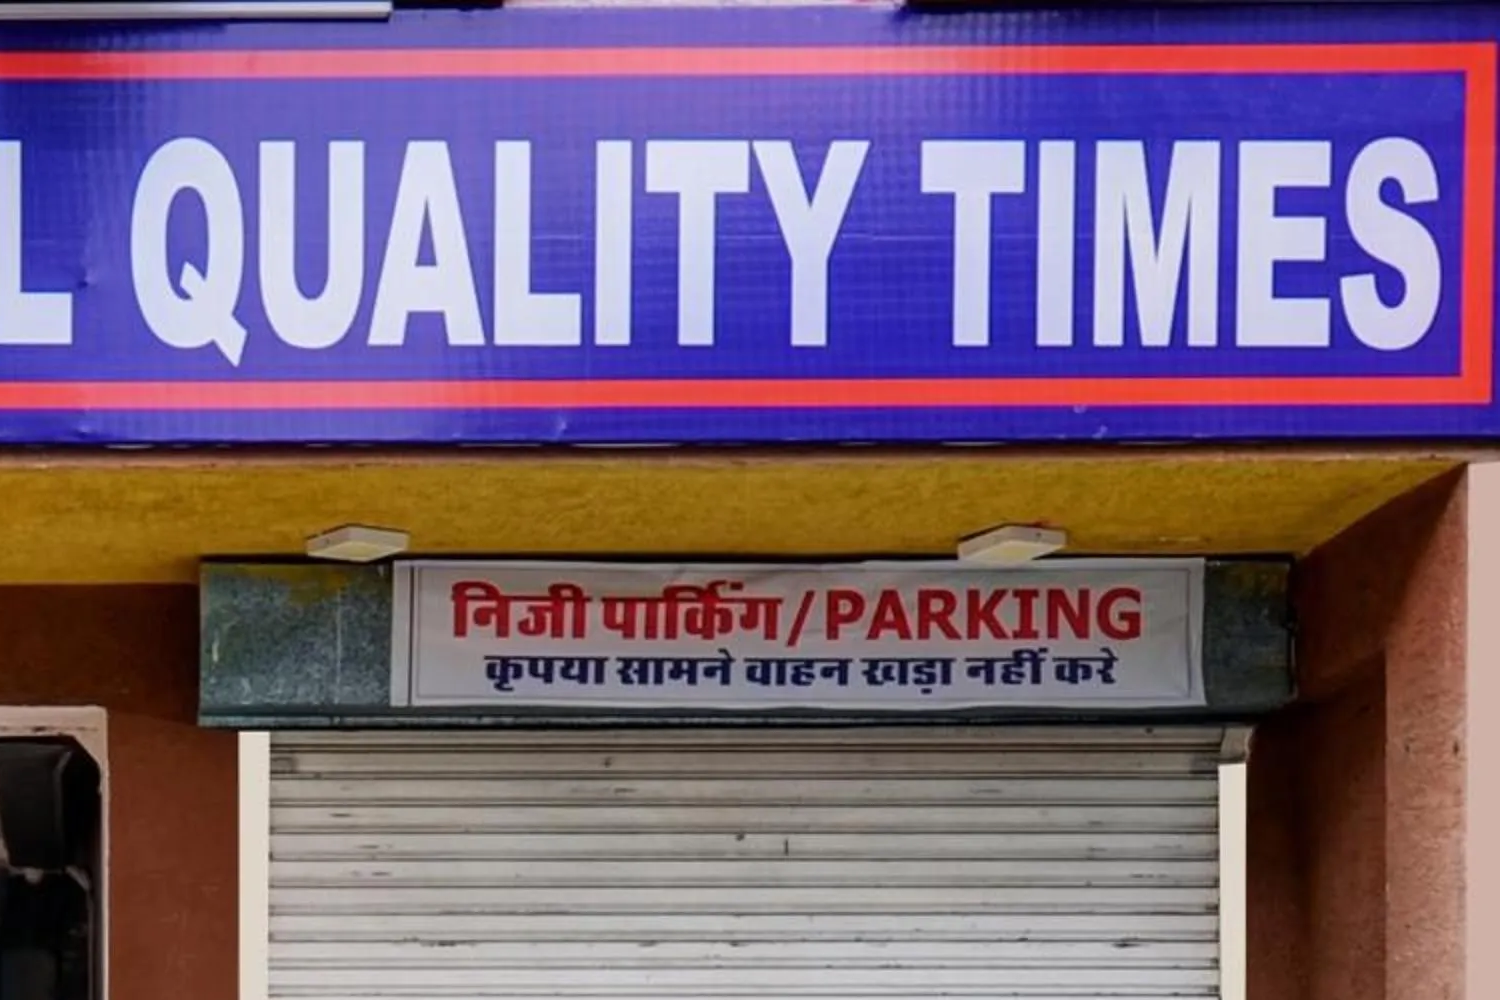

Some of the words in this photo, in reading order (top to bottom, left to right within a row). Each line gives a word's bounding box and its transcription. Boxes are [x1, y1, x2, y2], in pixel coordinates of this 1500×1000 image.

[131, 137, 870, 367] QUALITY
[921, 137, 1441, 350] TIMES
[451, 580, 592, 640] निजी
[484, 655, 610, 692] कृपया
[616, 648, 736, 686] सामने
[743, 656, 854, 687] वाहन
[860, 656, 957, 695] खड़ा
[964, 646, 1051, 686] नहीं
[1053, 646, 1120, 686] करे
